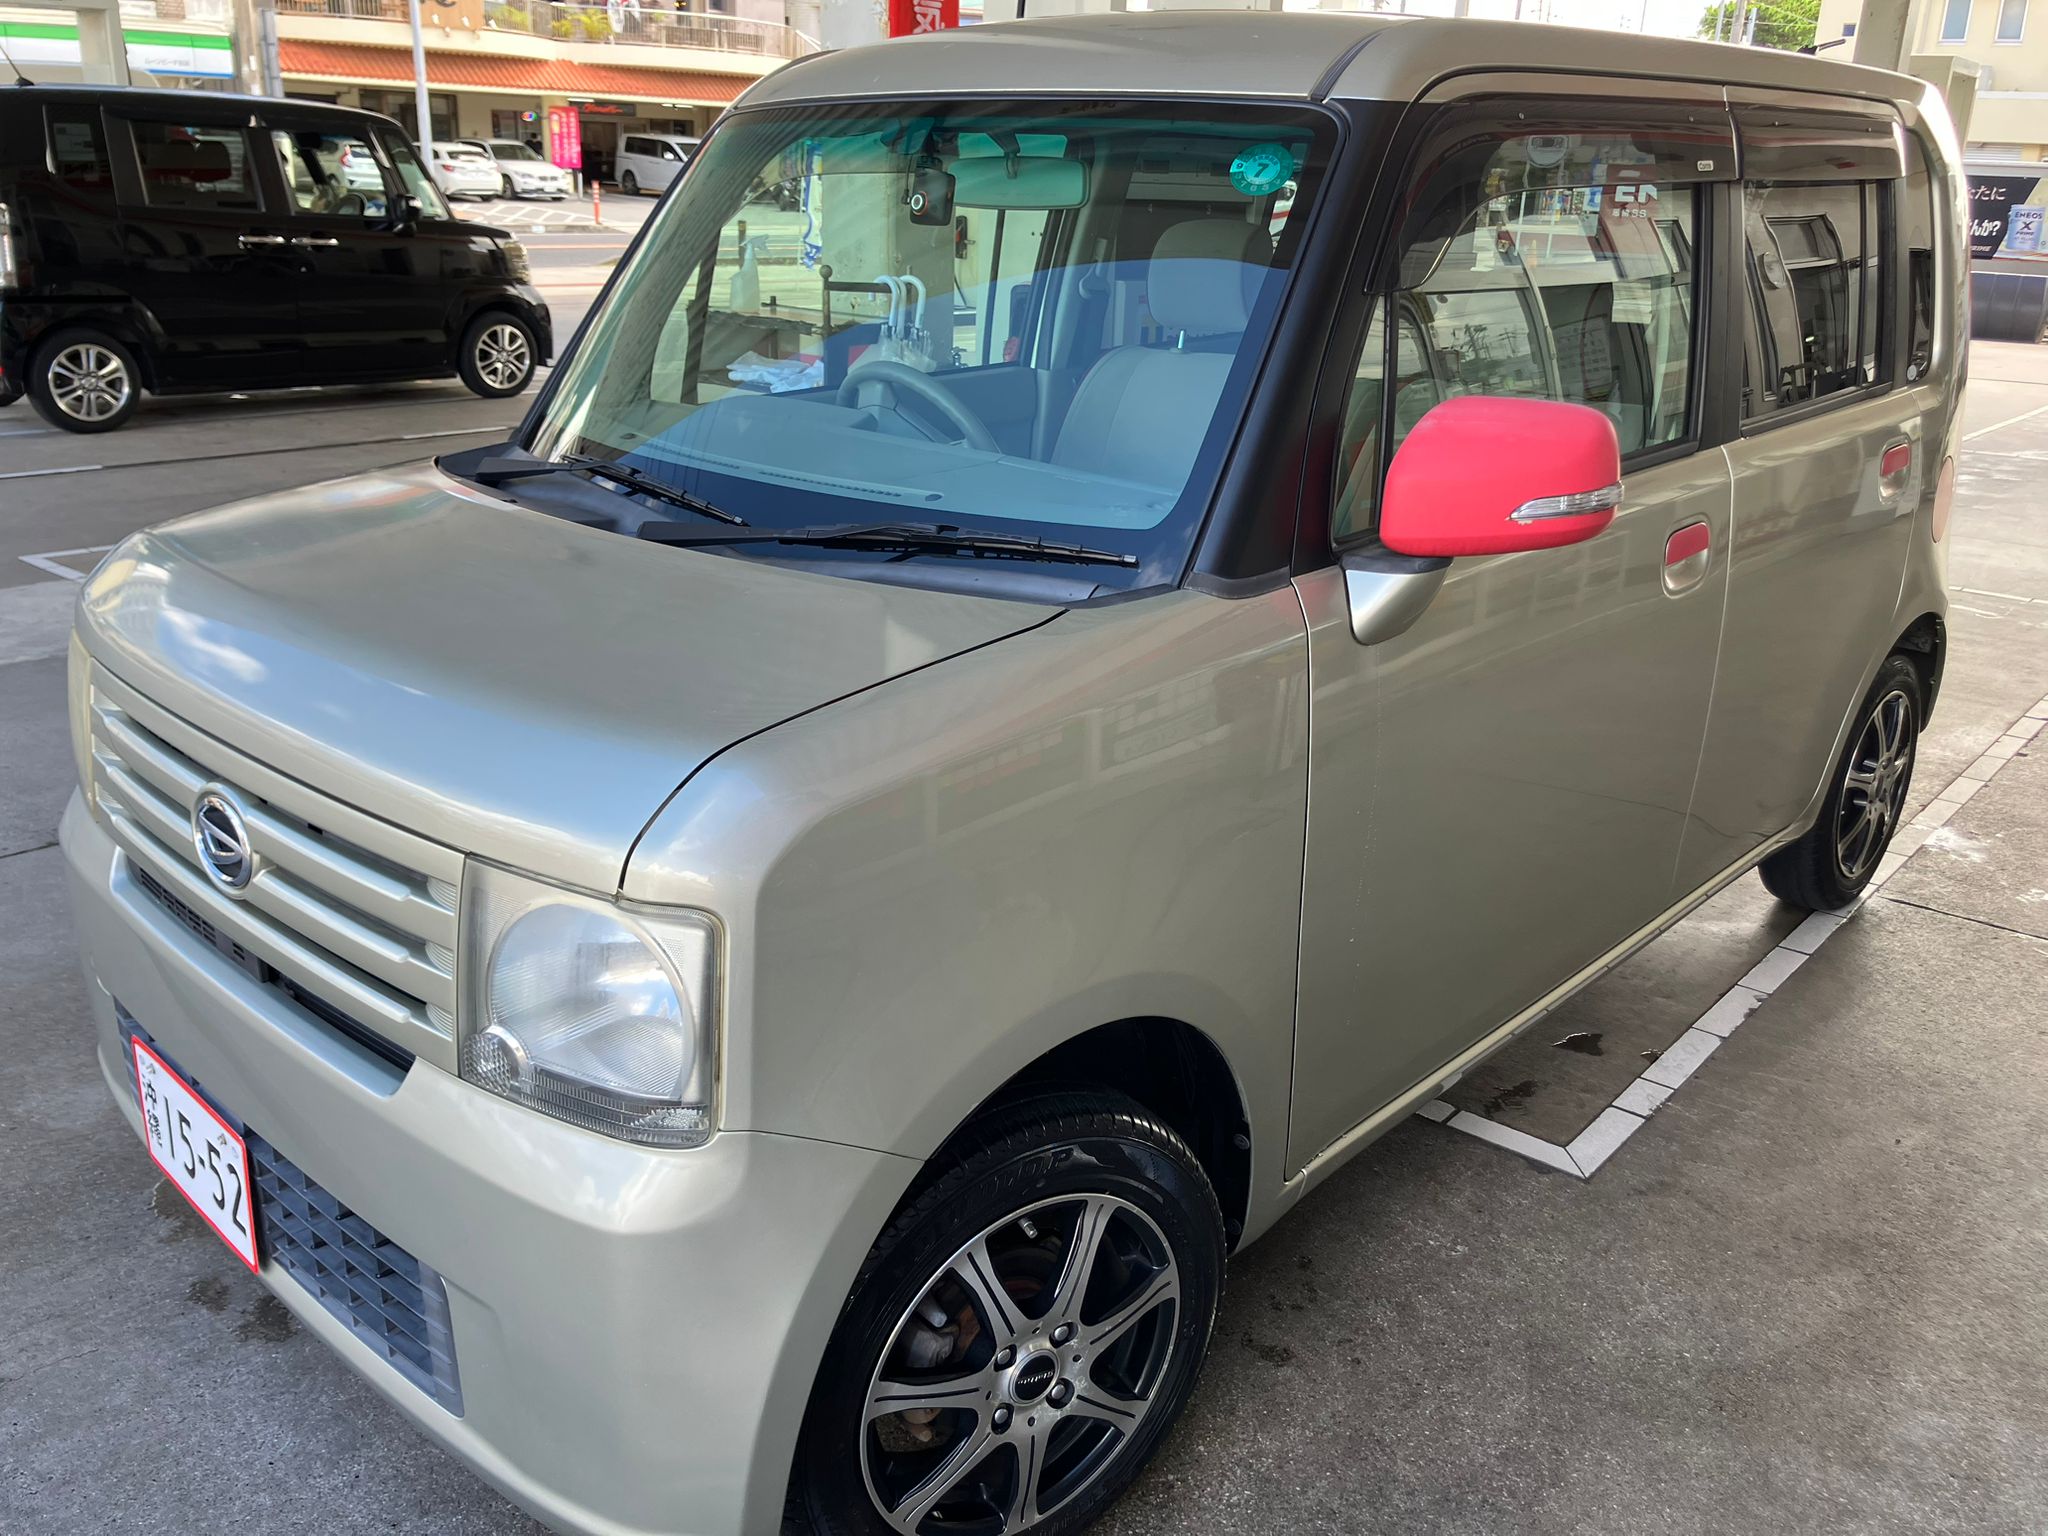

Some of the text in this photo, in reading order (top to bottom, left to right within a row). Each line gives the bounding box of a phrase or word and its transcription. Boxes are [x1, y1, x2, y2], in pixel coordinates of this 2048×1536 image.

[1253, 163, 1270, 178] 7
[2014, 211, 2043, 219] ENEOS
[163, 1095, 248, 1237] 15-52
